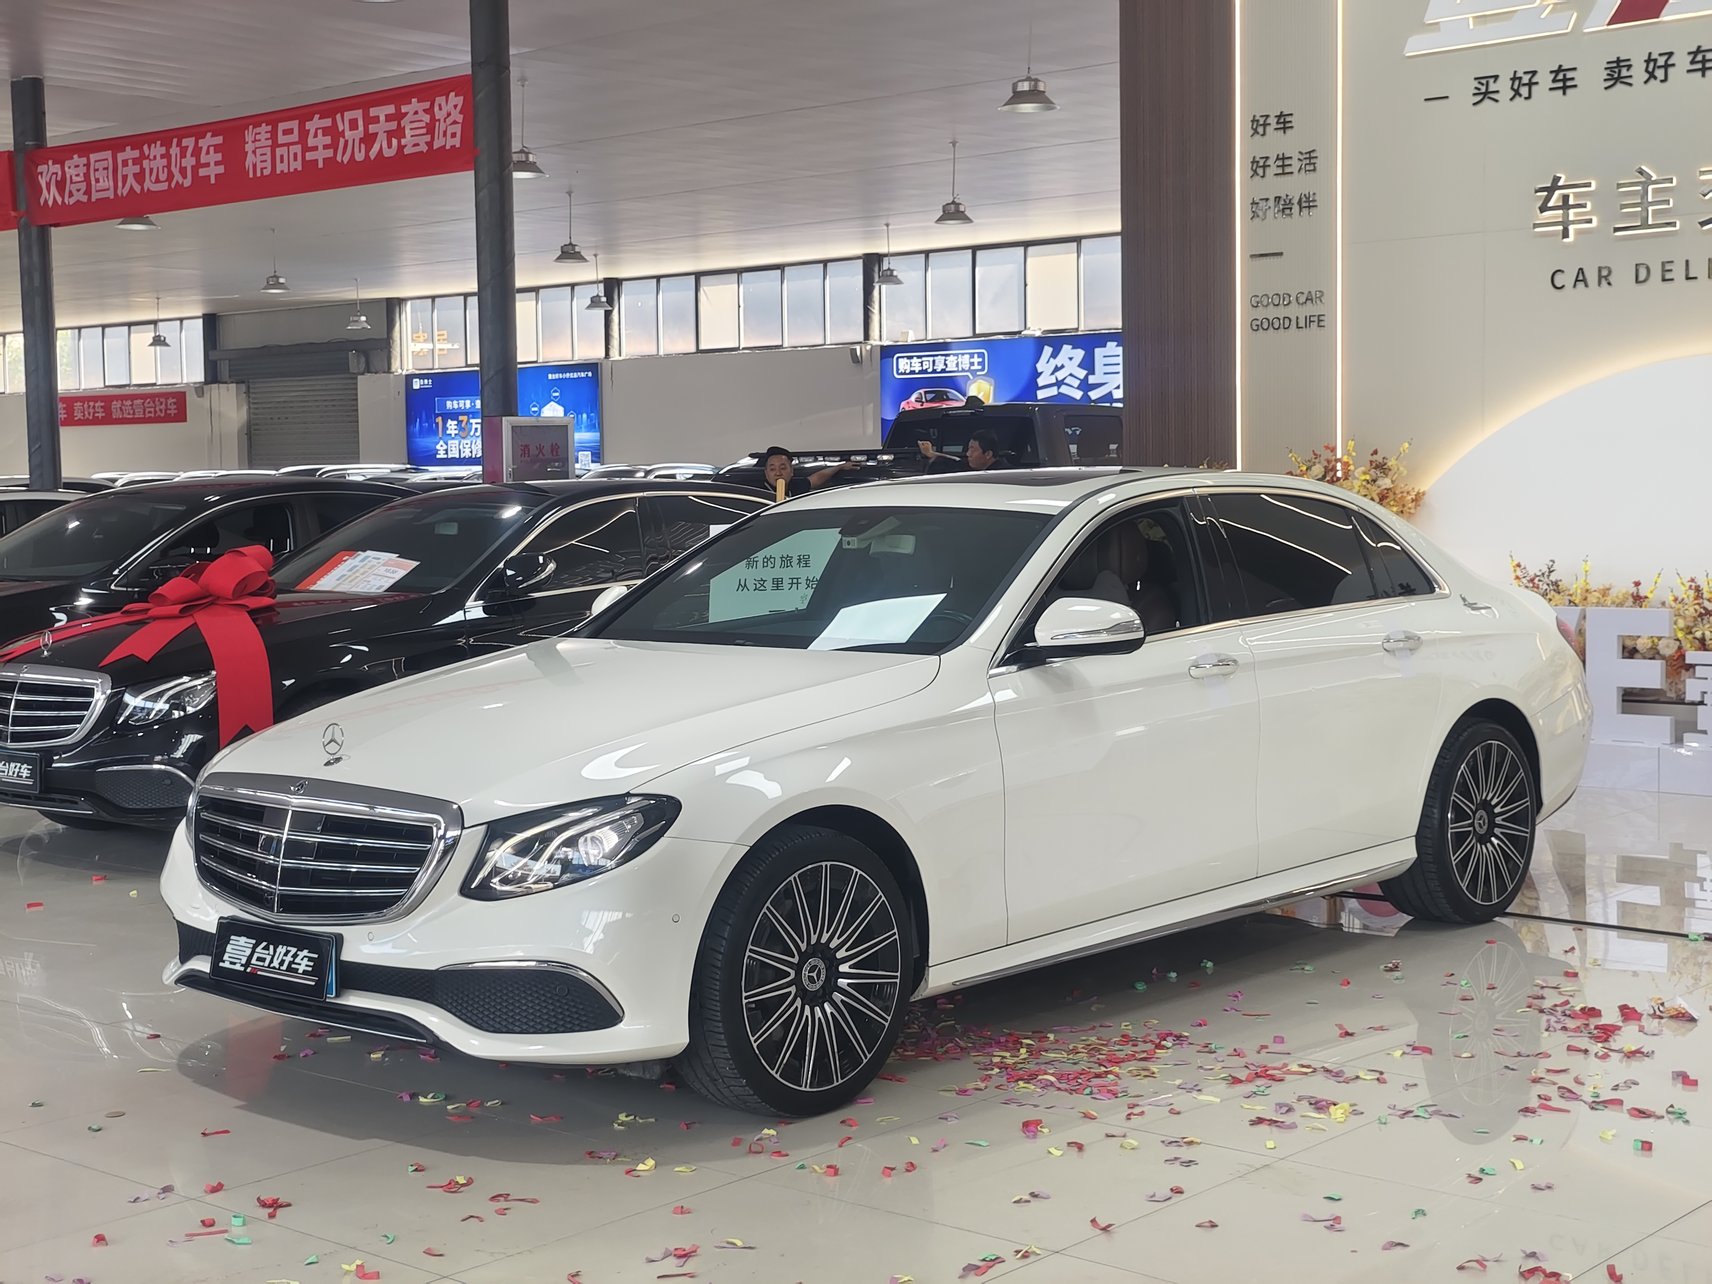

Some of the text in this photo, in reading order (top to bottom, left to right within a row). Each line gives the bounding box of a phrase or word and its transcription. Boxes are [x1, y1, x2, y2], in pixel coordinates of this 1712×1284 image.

[1471, 45, 1712, 106] 买好车 卖好车
[1250, 111, 1294, 137] 好车
[36, 91, 465, 209] 欢度国庆选好车 精品车况无套路
[1250, 149, 1318, 178] 好生活
[1250, 192, 1318, 220] 好陪伴
[1532, 165, 1712, 242] 车主
[1550, 266, 1613, 290] CAR
[1250, 290, 1325, 308] GOOD CAR
[1250, 314, 1326, 332] GOOD LIFE
[898, 354, 983, 373] 购车可享查博士
[1036, 341, 1123, 400] 终身
[73, 401, 106, 420] 卖好车
[111, 397, 178, 419] 就选壹台好车
[435, 440, 482, 459] 全国保修
[520, 442, 560, 458] 消火栓
[744, 554, 811, 570] 新的旅程
[736, 576, 819, 592] 从这里开始
[218, 935, 319, 974] 壹台好车
